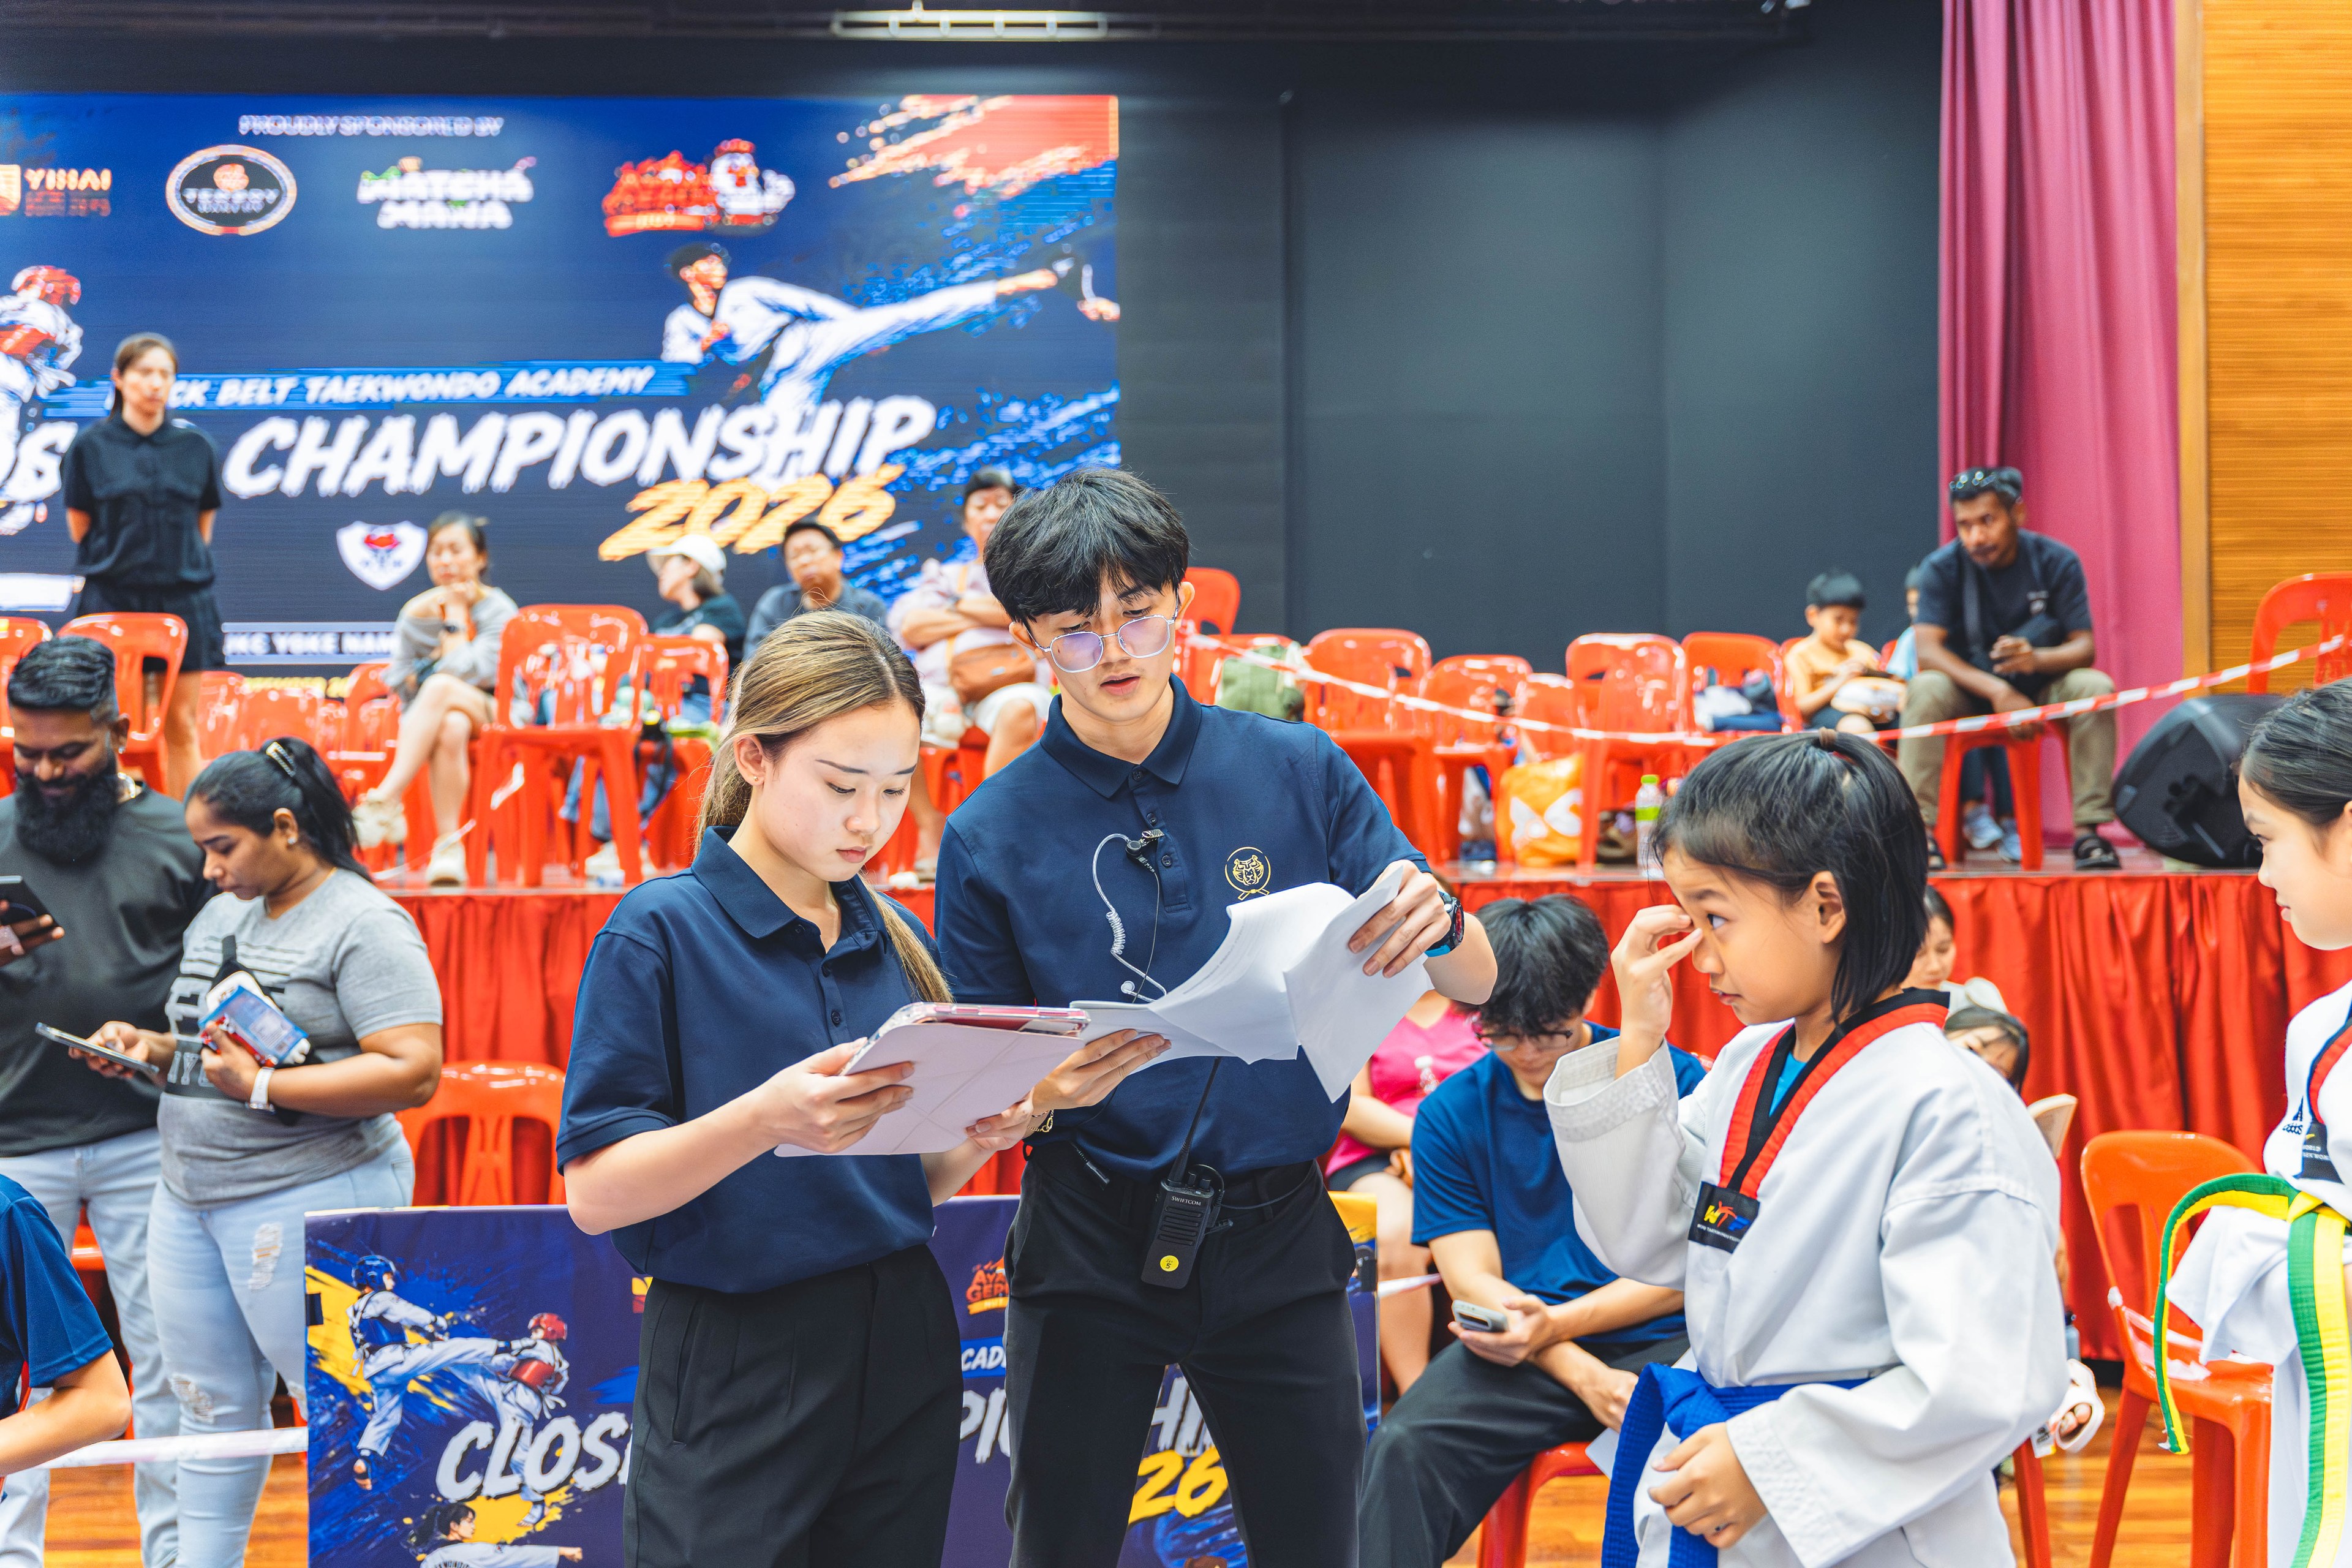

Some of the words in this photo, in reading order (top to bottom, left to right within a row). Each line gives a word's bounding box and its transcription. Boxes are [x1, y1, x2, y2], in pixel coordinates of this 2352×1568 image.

[239, 115, 339, 136] PROUDLY
[339, 115, 473, 137] SPONSORED
[473, 116, 504, 137] BY
[357, 168, 533, 204] MATCHA
[216, 376, 299, 407] BELT
[305, 369, 502, 404] TAEKWONDO
[505, 365, 656, 398] ACADEMY
[222, 394, 937, 499] CHAMPIONSHIP
[597, 463, 905, 562] 2026
[1171, 1196, 1202, 1206] SWIFTCOM
[971, 1269, 1007, 1287] AYA
[436, 1412, 633, 1502] CLOS
[1128, 1446, 1229, 1519] 26
